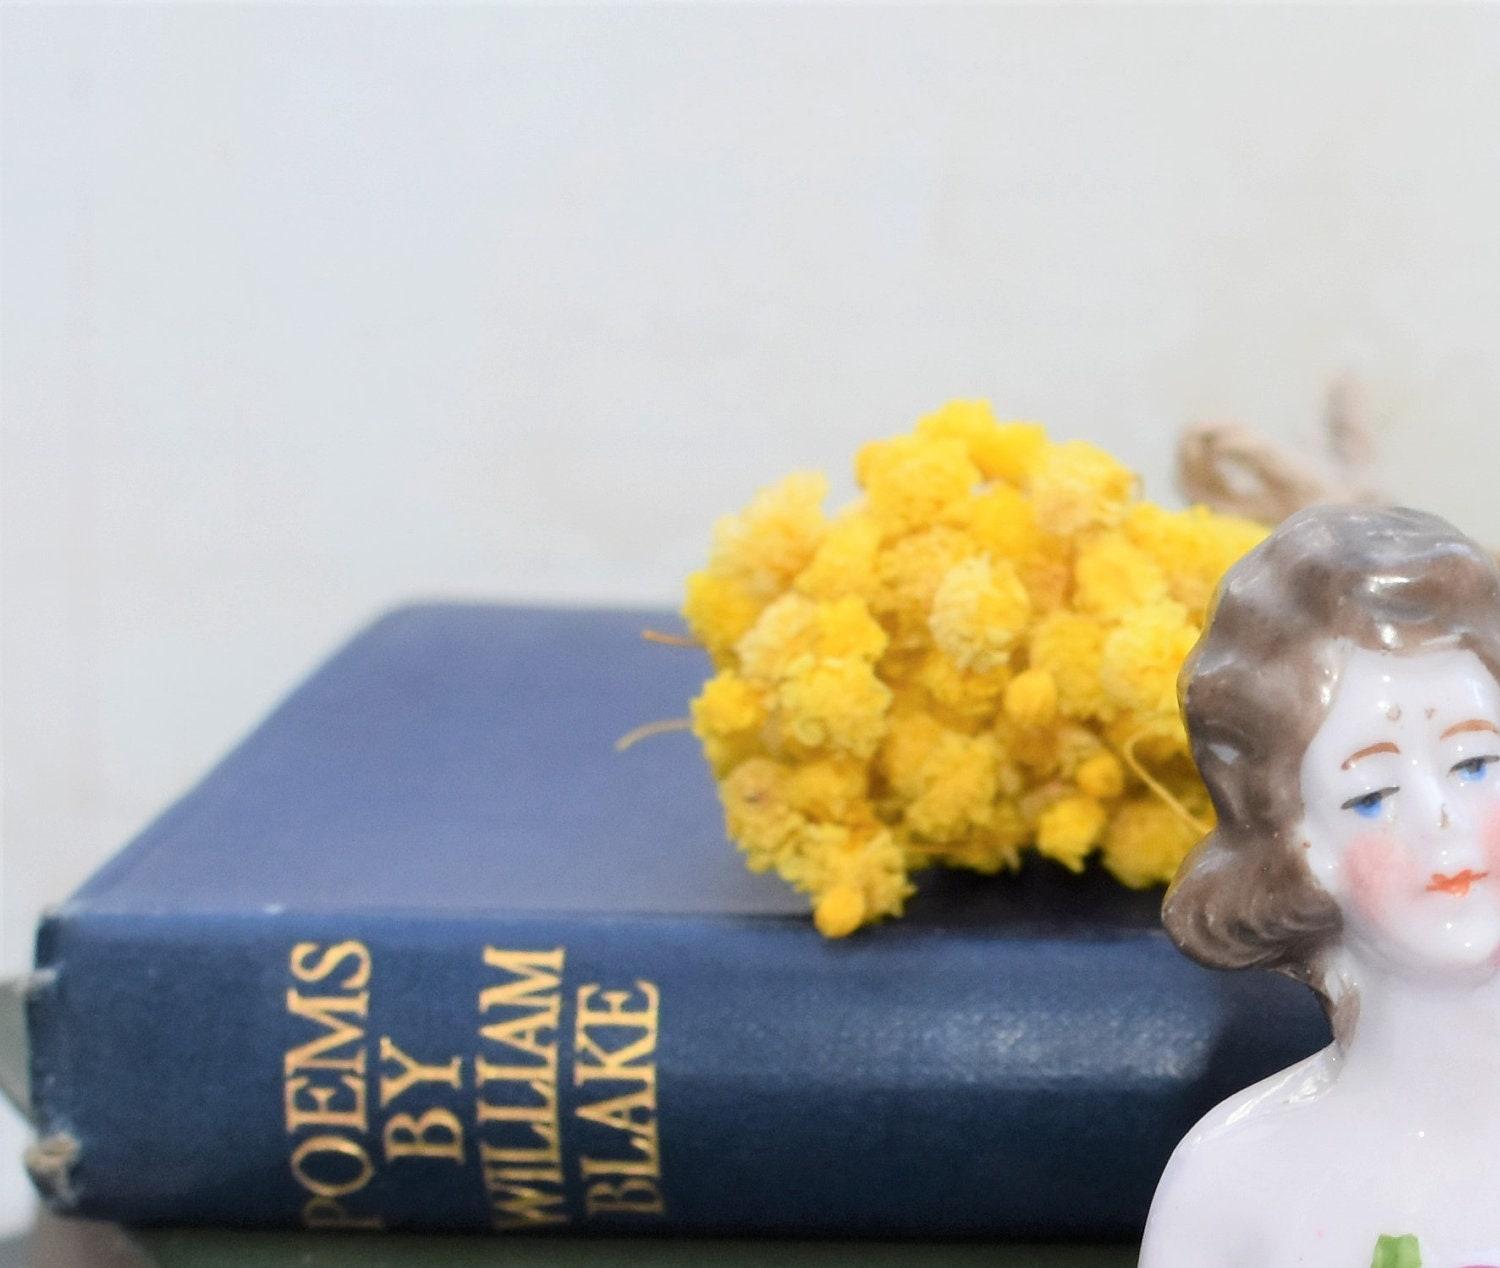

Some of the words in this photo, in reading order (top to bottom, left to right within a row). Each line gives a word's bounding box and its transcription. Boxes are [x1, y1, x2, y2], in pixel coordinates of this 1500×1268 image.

[284, 939, 387, 1231] POEMS
[380, 1036, 465, 1165] BY
[475, 944, 570, 1231] WILLIAM
[574, 979, 665, 1215] BLAKE
